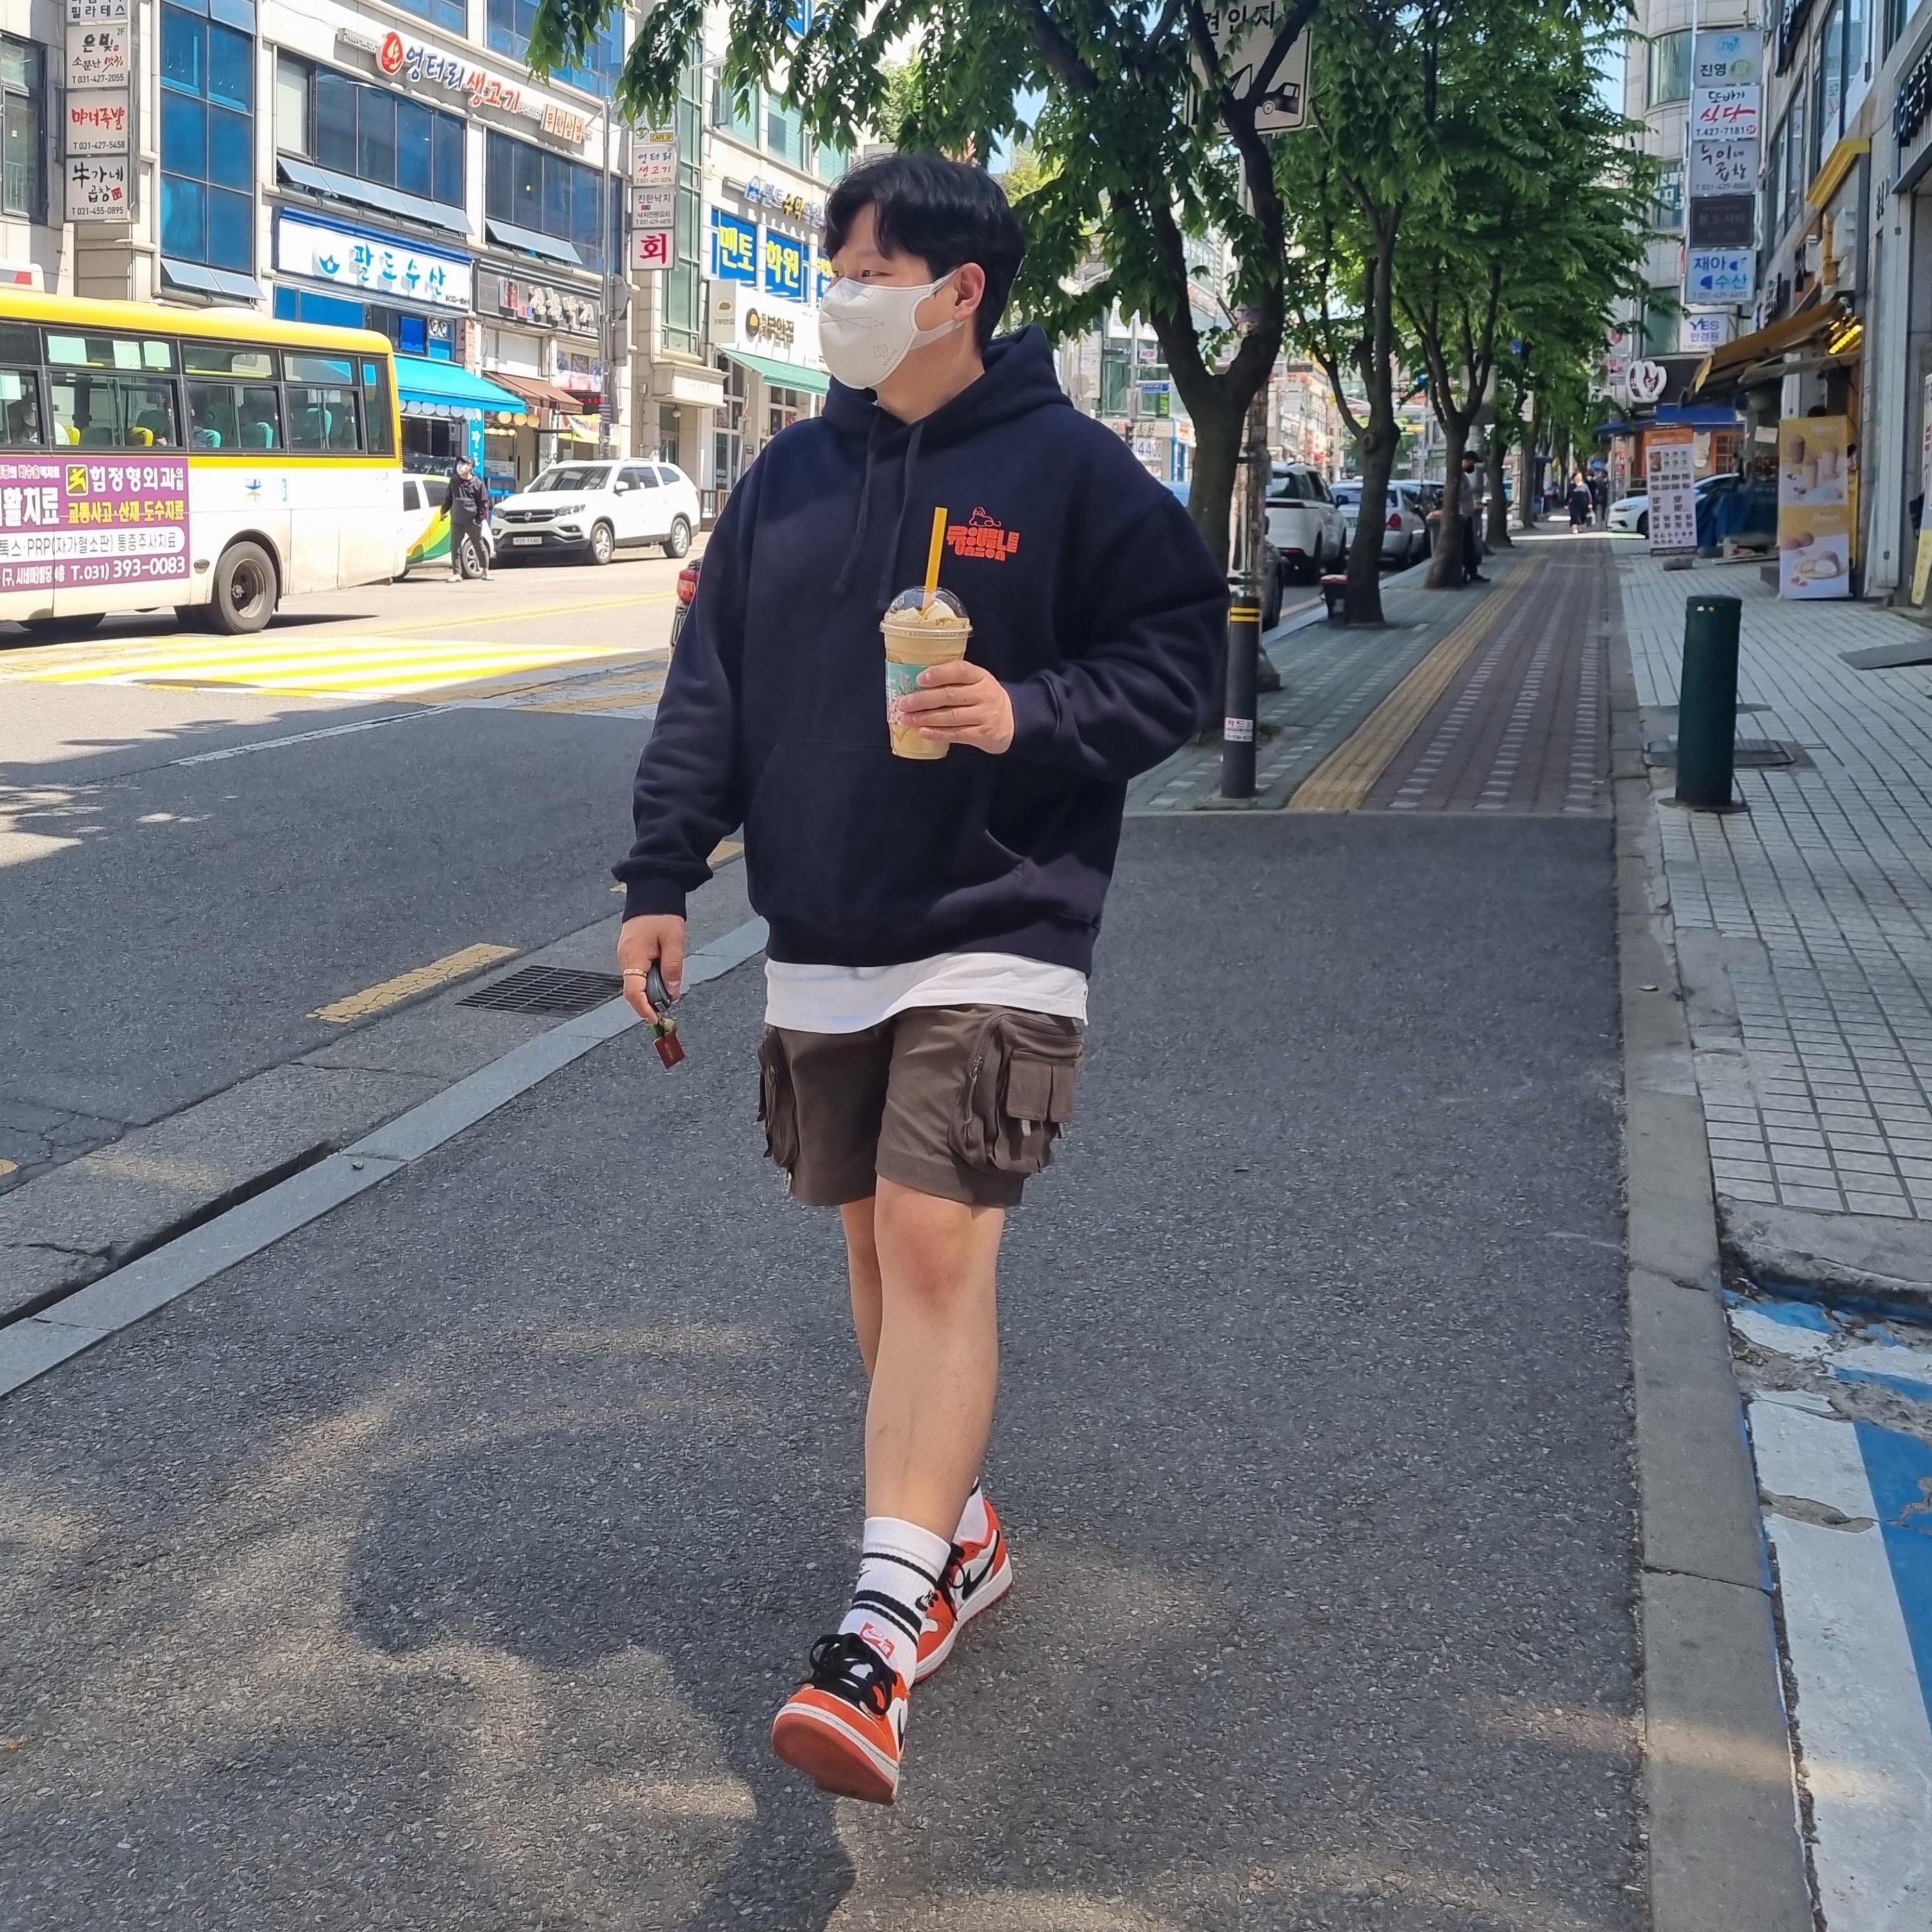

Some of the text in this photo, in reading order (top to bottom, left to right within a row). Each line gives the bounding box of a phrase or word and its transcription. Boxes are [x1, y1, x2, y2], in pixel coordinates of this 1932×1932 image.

[71, 5, 126, 19] 필라테스
[117, 28, 125, 36] 2F
[72, 56, 102, 71] 소문난
[1700, 63, 1727, 77] 진영
[78, 74, 124, 83] 031-427-2055
[1708, 91, 1745, 103] 또바기
[1700, 103, 1756, 124] 식당
[78, 141, 125, 150] 031-427-5458
[638, 153, 672, 164] 엉터리
[638, 165, 671, 177] 생고기
[1715, 161, 1746, 182] 곱창
[88, 185, 110, 203] 곱창
[638, 193, 671, 203] 진한낙지
[77, 207, 124, 215] 031-455-0895
[639, 233, 667, 264] 회
[719, 226, 799, 288] 멘토 학원
[354, 242, 446, 295] 팔도수산
[1715, 273, 1747, 289] 수산
[1689, 317, 1720, 330] YES
[0, 487, 60, 527] 활치료
[144, 499, 185, 521] 도수치료
[118, 532, 176, 551] 통증주사치료
[113, 556, 185, 578] 393-0083
[877, 1641, 891, 1655] AIR
